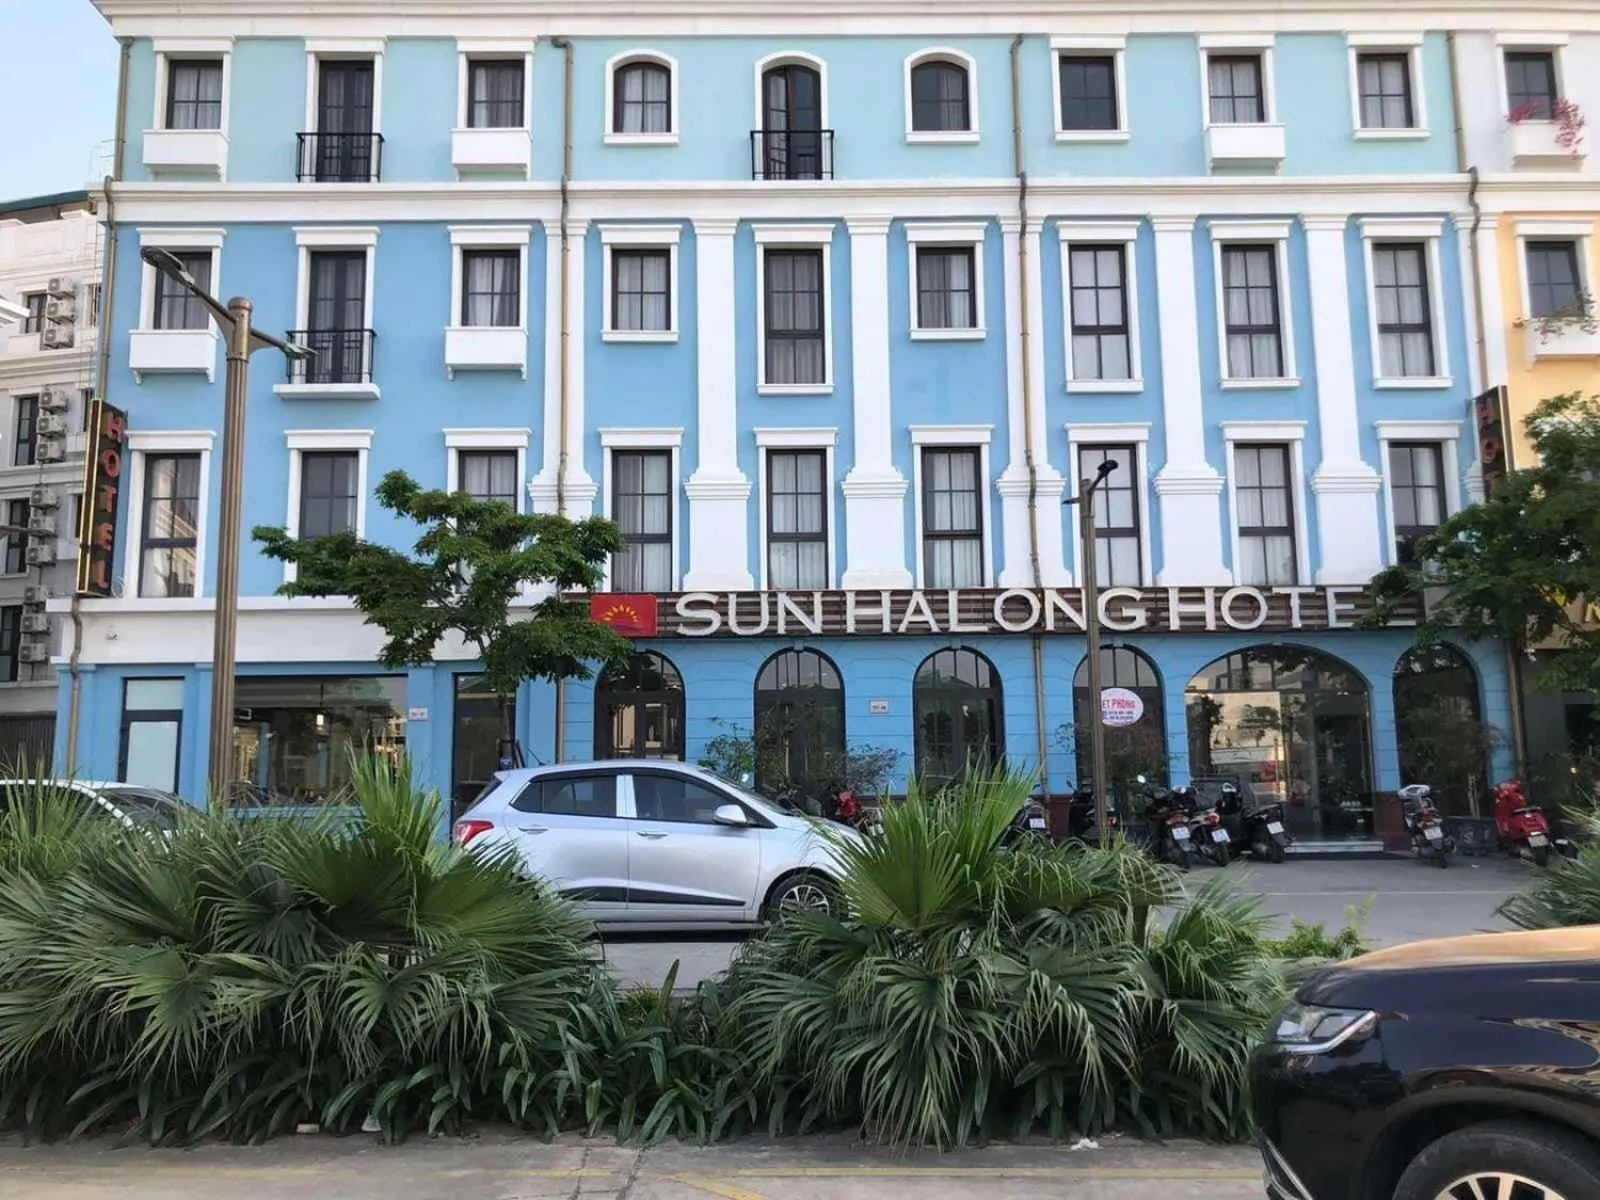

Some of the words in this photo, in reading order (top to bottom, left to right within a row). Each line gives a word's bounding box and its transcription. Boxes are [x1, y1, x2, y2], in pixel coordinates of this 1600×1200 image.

[97, 411, 125, 589] HOTEL
[675, 592, 823, 636] SUN
[846, 587, 1148, 632] HALONG
